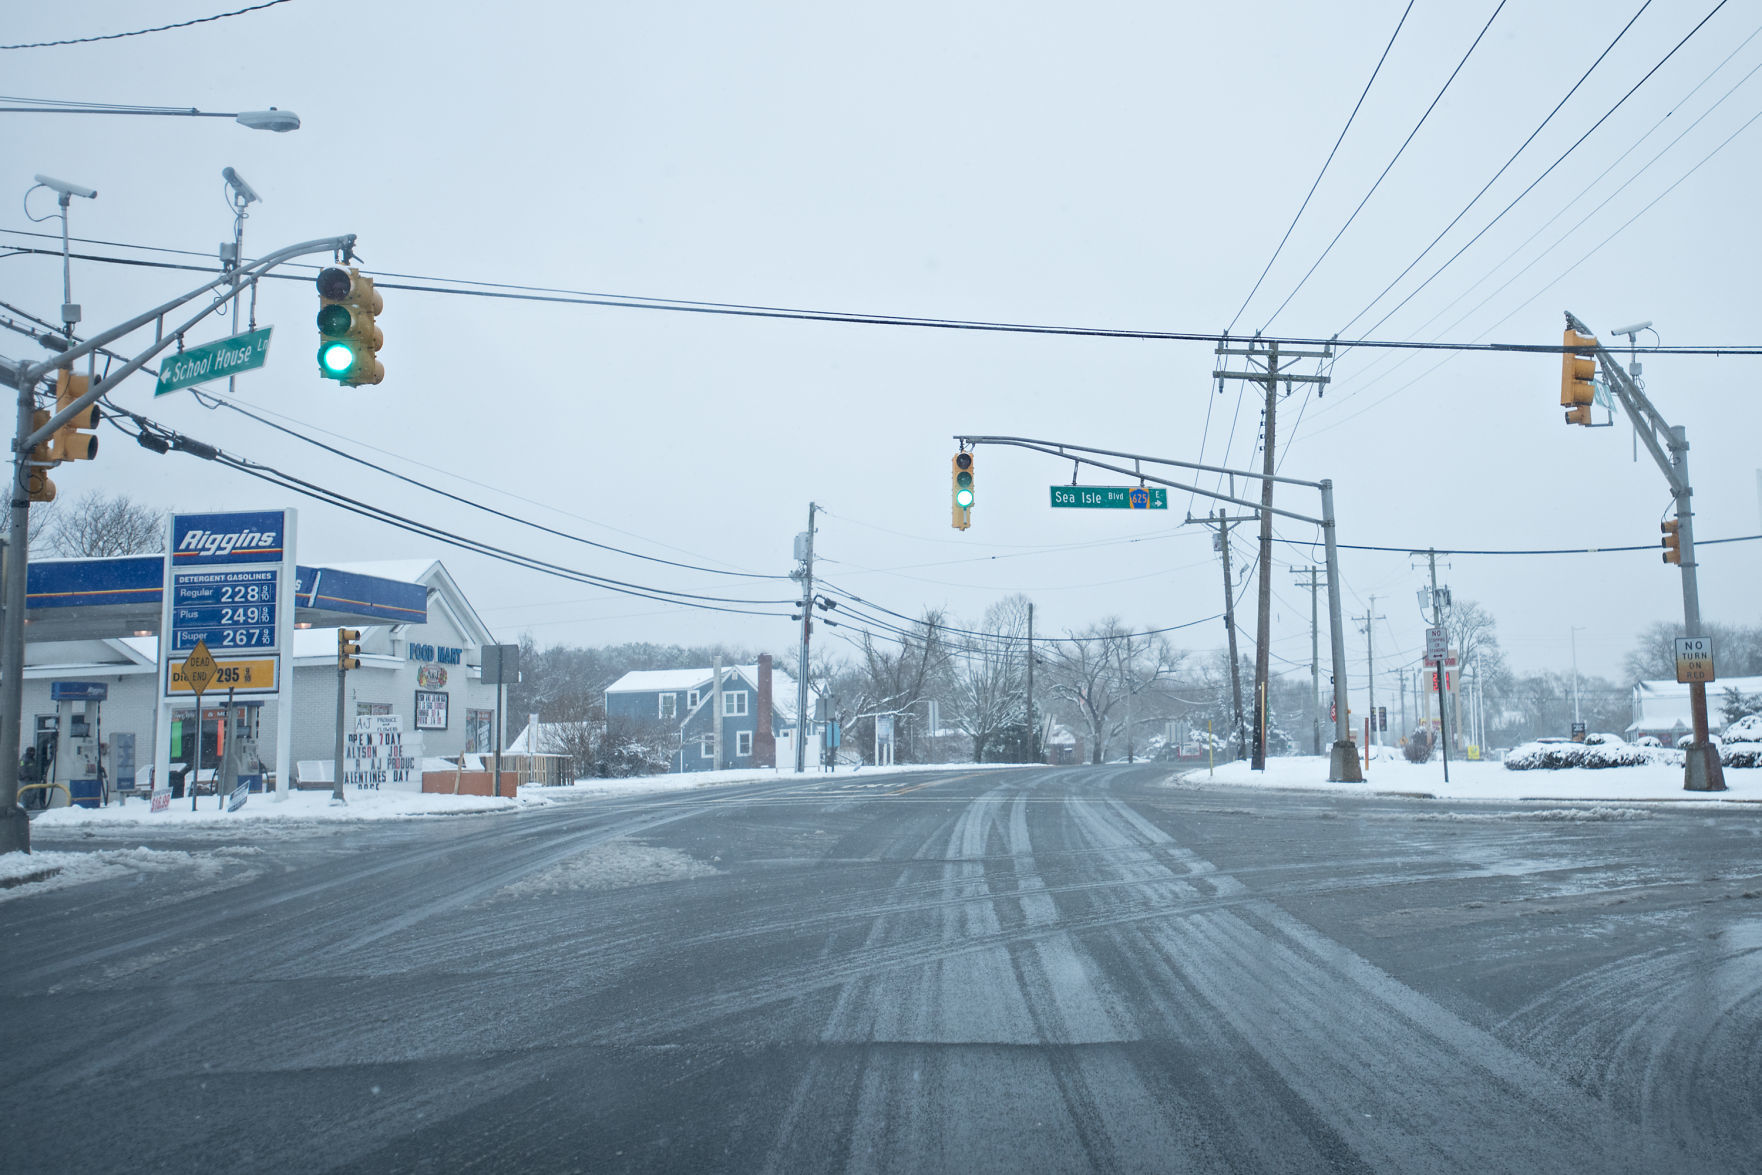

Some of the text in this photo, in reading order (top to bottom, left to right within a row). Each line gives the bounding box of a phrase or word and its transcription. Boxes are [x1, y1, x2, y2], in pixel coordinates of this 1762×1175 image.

[173, 338, 269, 382] School House Ln
[1055, 491, 1124, 504] Sea Isle Blvd
[1132, 493, 1147, 503] 625
[179, 529, 277, 556] Riggins
[179, 573, 272, 583] DETERGENT GASOLINES
[180, 588, 214, 599] Regular
[220, 586, 259, 602] 228
[180, 610, 198, 618] Plus
[220, 607, 259, 624] 249
[181, 631, 208, 641] Super
[222, 629, 260, 646] 267
[1685, 640, 1703, 650] NO
[409, 642, 463, 665] FOOD MART
[1682, 652, 1707, 660] TURN
[190, 657, 210, 667] DEAD
[1689, 661, 1702, 669] ON
[192, 672, 207, 681] END
[216, 667, 240, 683] 295
[1686, 671, 1705, 679] RED
[388, 745, 403, 757] JOE
[393, 770, 409, 782] DAY
